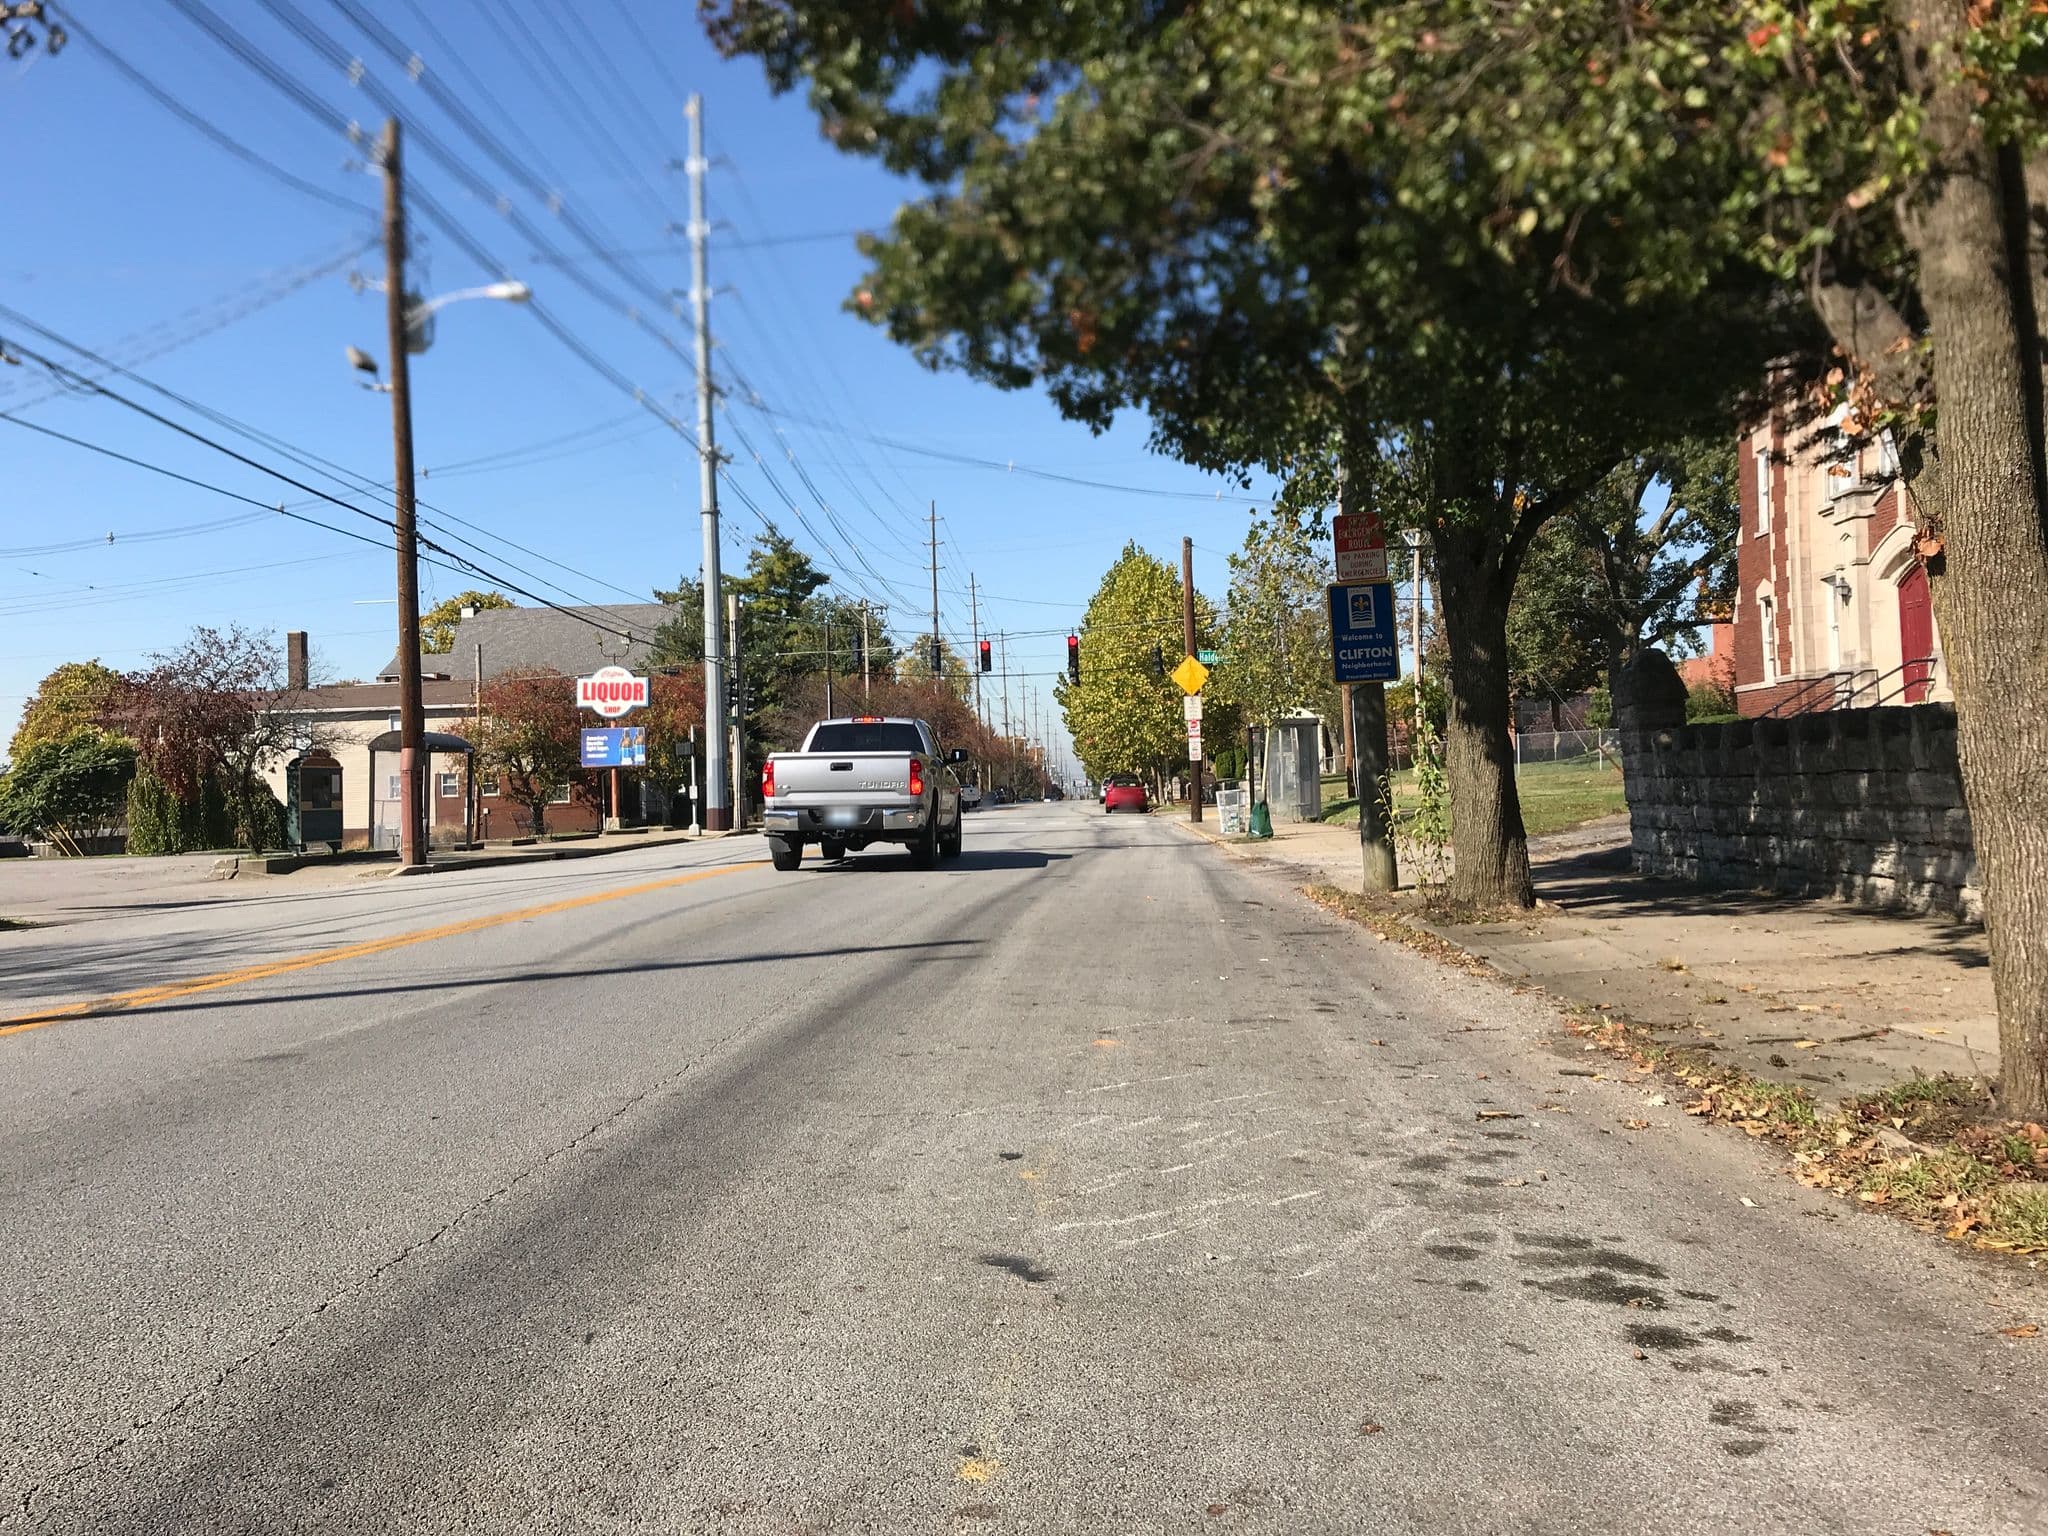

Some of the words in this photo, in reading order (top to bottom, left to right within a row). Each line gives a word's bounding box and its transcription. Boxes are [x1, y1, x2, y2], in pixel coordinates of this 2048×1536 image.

[1353, 551, 1381, 560] PARKING
[1350, 560, 1374, 569] DURING
[1340, 568, 1385, 578] EMERGENCIES
[1341, 633, 1373, 641] Welcome
[1375, 632, 1383, 640] to
[1338, 646, 1393, 660] CLIFTON
[582, 682, 644, 702] LIQUOR
[603, 706, 621, 714] SHOP
[858, 781, 908, 789] TUNDRA
